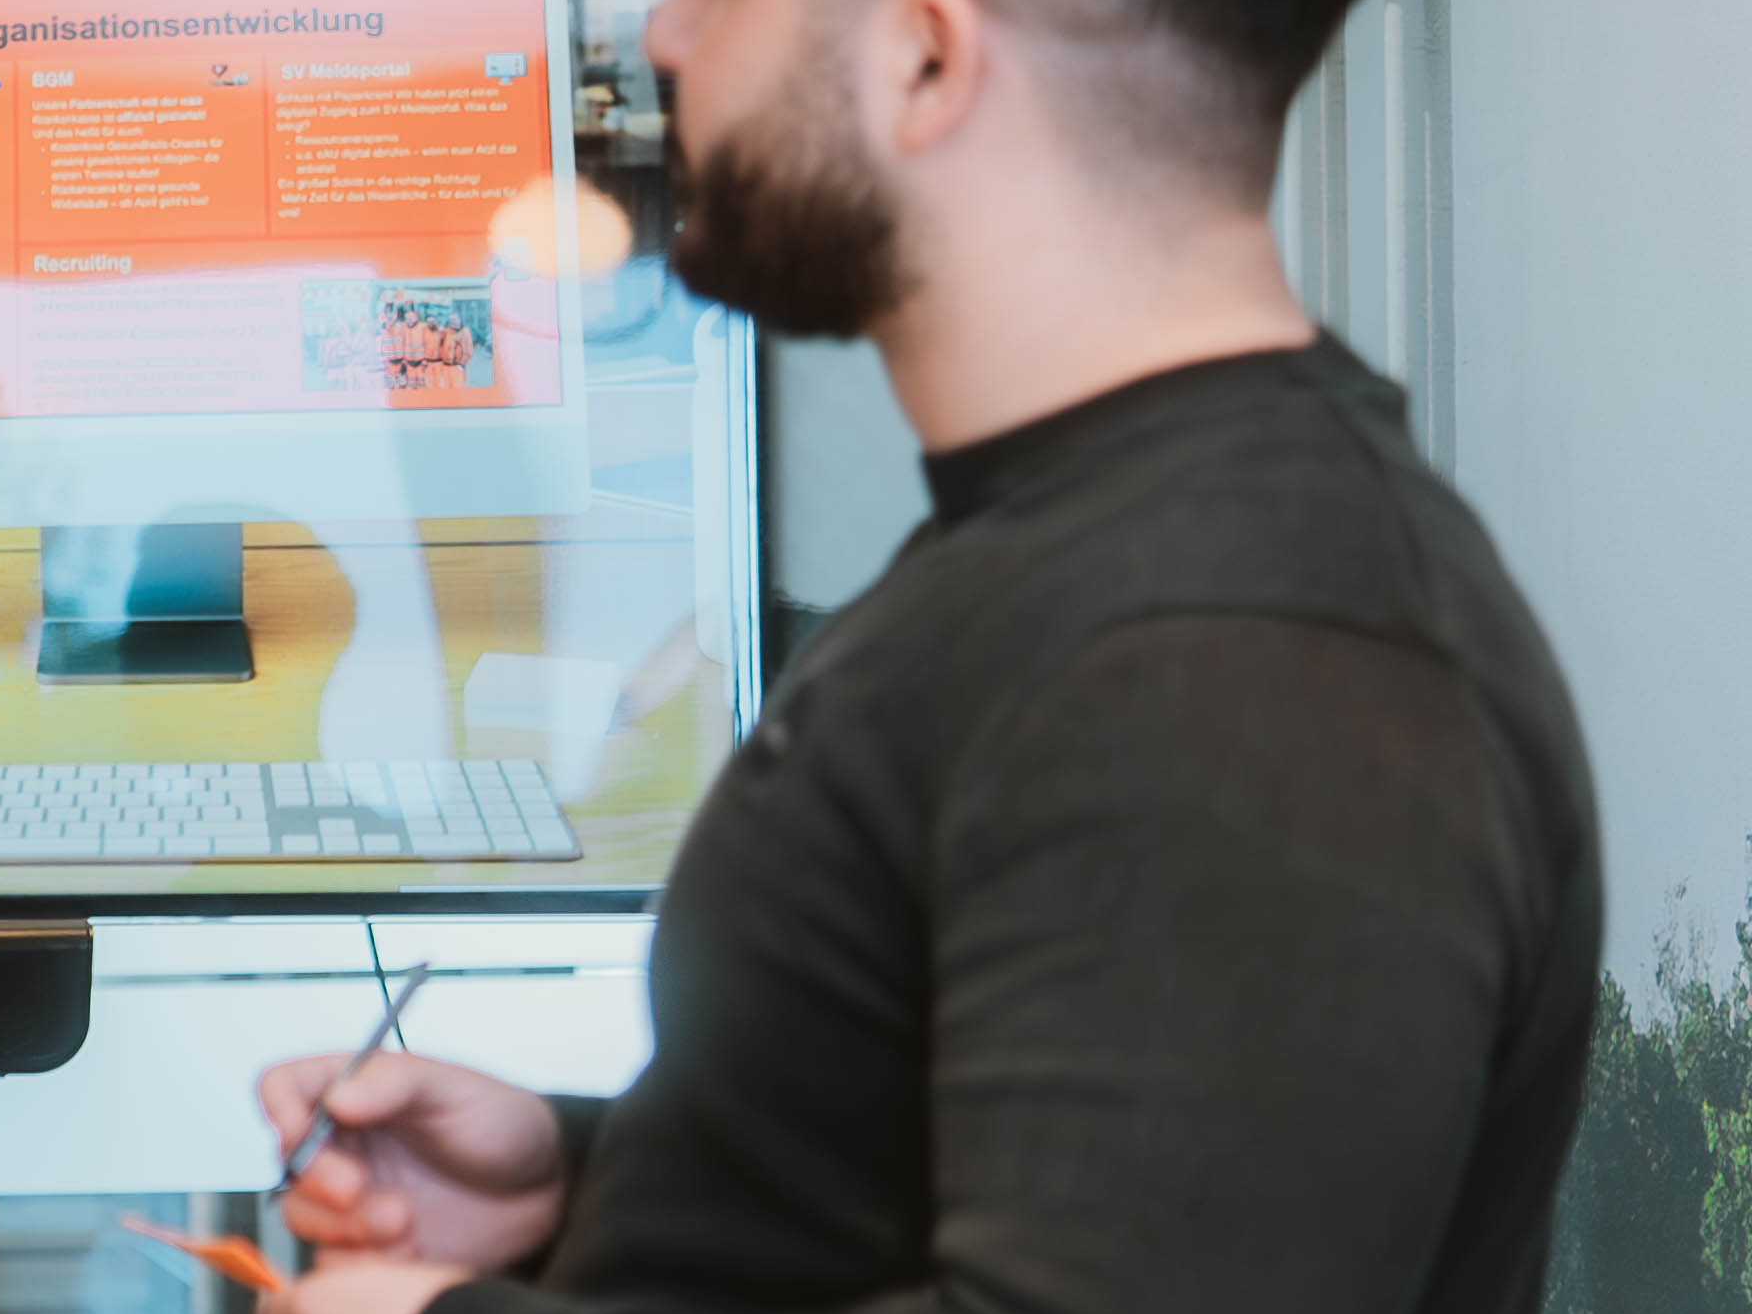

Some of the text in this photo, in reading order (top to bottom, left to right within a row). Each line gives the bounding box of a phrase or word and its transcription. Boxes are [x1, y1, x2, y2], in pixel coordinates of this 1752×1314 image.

[32, 70, 74, 87] BGM
[281, 62, 410, 79] SV Meldeportal
[33, 253, 133, 274] Recruiting
